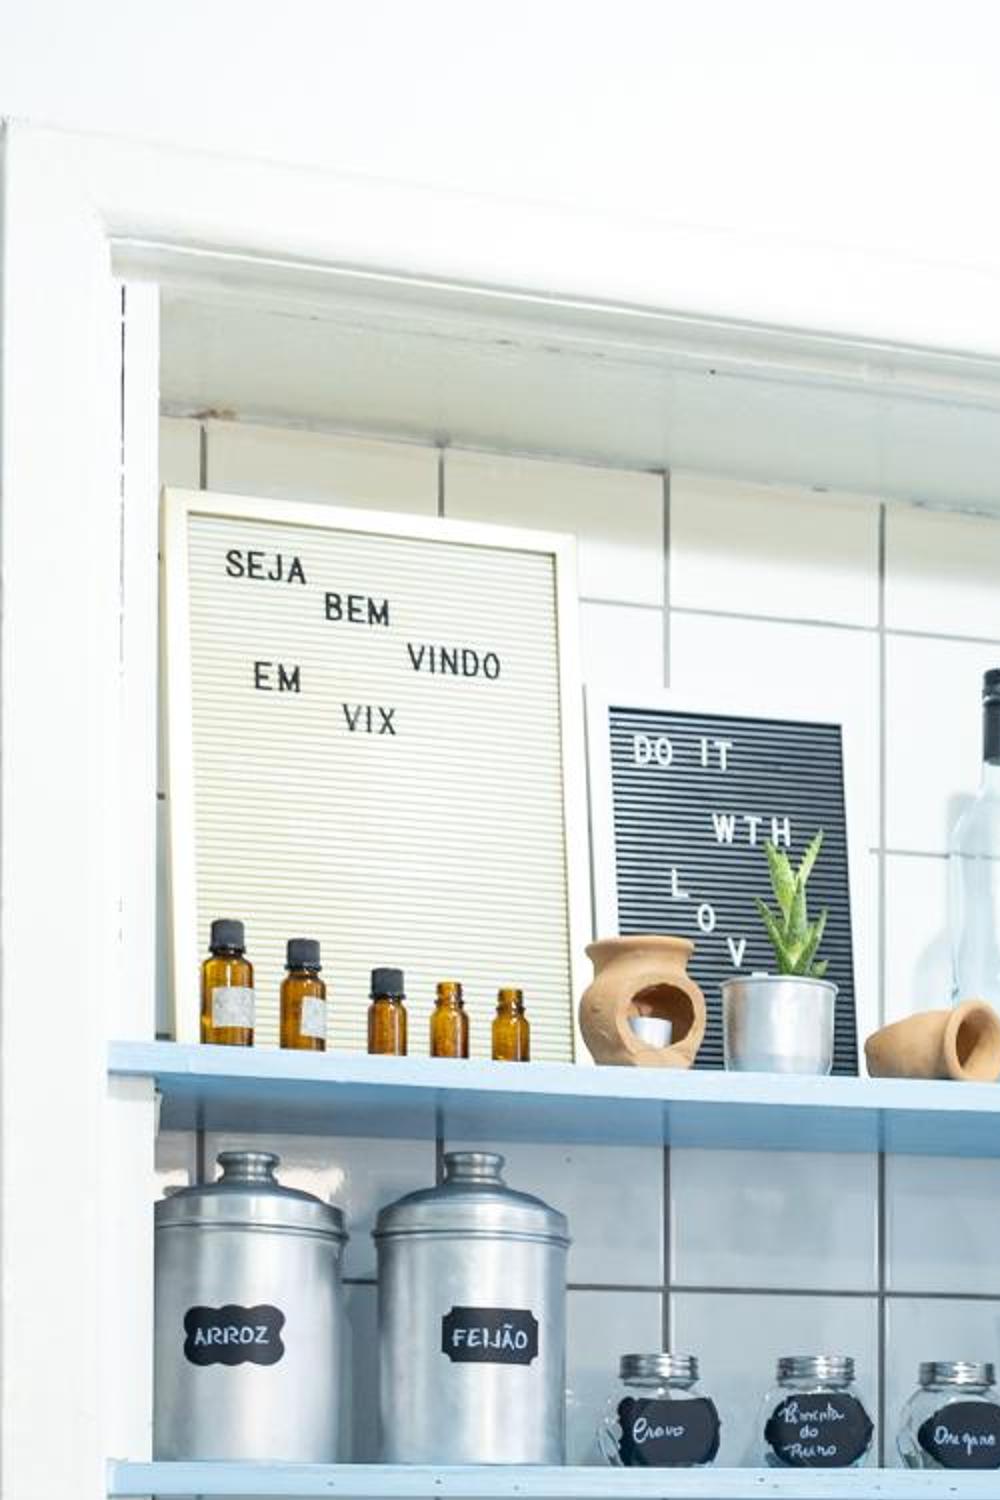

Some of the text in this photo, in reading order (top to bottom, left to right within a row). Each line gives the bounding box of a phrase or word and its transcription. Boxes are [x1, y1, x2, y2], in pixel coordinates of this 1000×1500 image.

[225, 548, 307, 585] SEJA
[324, 592, 390, 627] BEM
[253, 661, 301, 693] EM
[407, 643, 501, 680] VINDO
[342, 703, 397, 735] VIX
[633, 734, 733, 772] DO IT
[194, 1325, 270, 1346] ARROZ
[452, 1323, 528, 1350] FEIJÃO
[632, 1416, 685, 1444] Cravo
[799, 1424, 819, 1439] do
